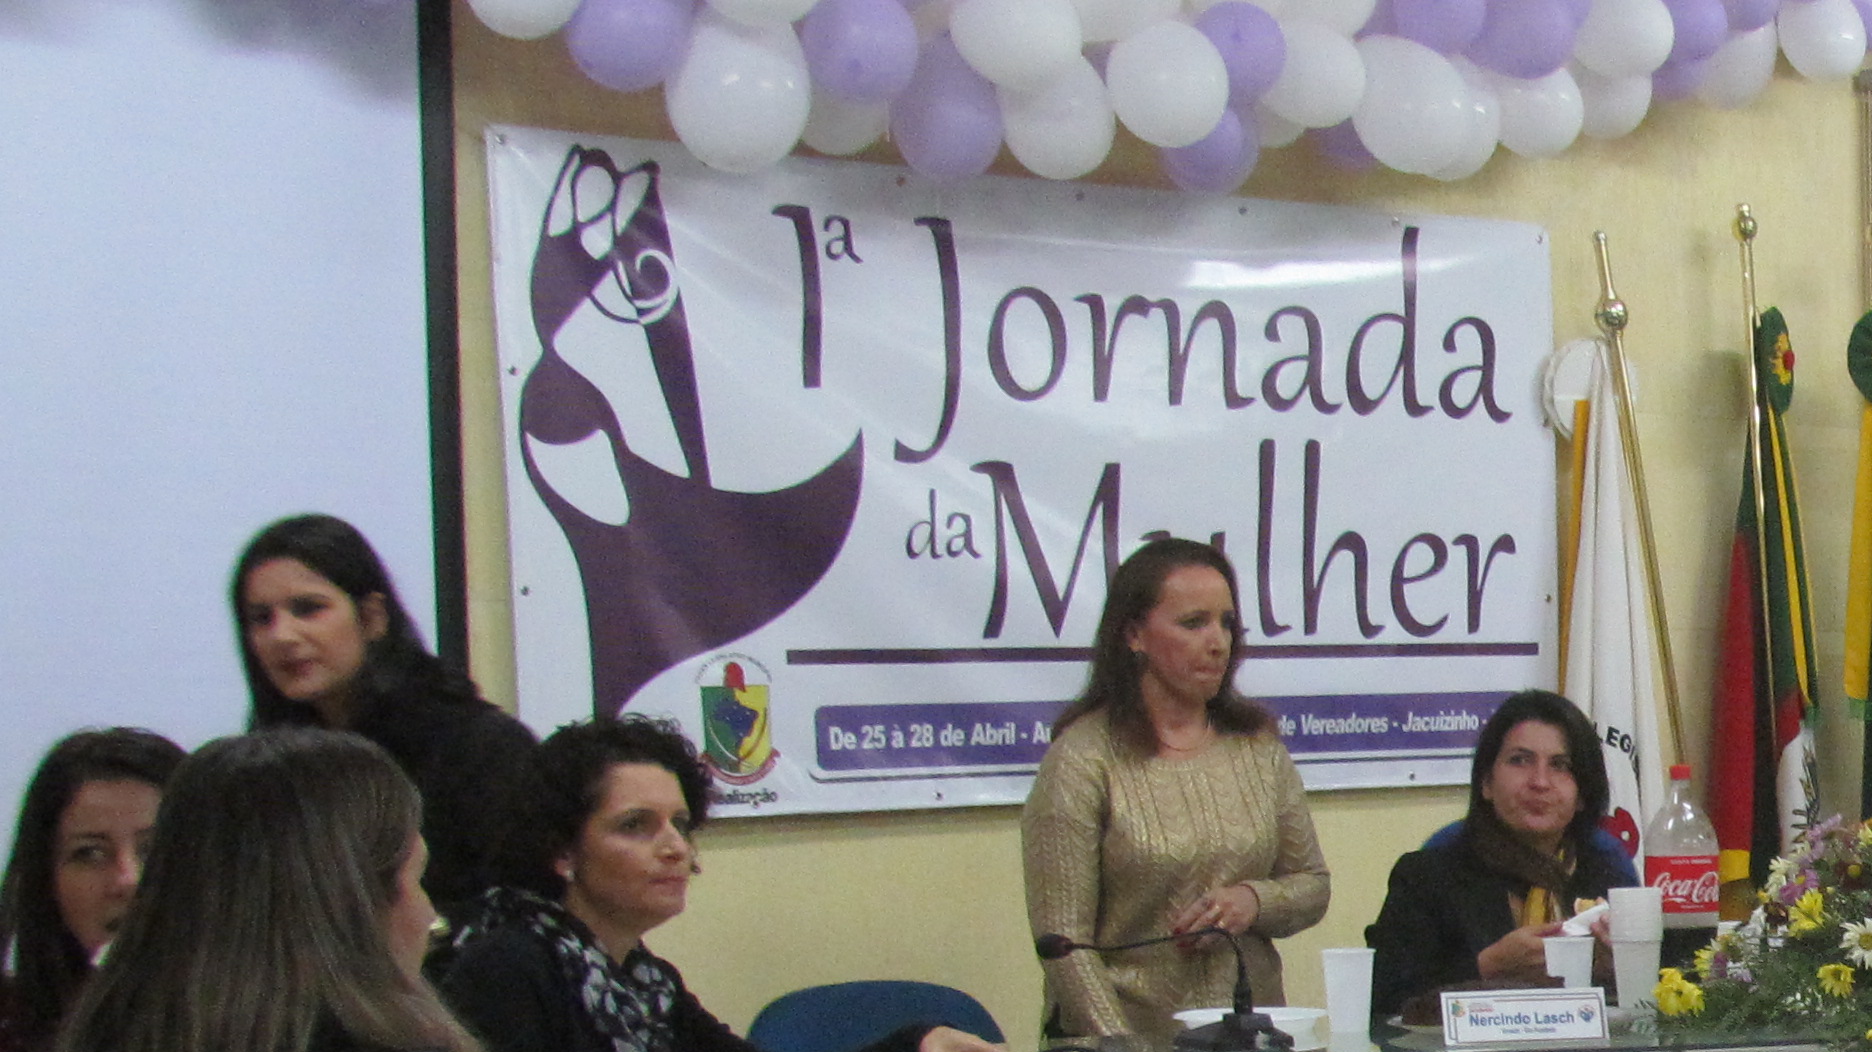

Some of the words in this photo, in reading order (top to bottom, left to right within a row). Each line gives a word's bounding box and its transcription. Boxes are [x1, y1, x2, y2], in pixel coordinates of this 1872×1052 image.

[894, 215, 1513, 464] Jornada
[905, 489, 982, 560] da
[970, 438, 1517, 640] Mlher
[829, 726, 857, 750] De
[861, 725, 886, 749] 25
[910, 723, 934, 747] 28
[940, 724, 965, 747] de
[970, 721, 1017, 746] Abril
[1301, 712, 1388, 736] Vereadores
[1403, 710, 1480, 733] Jacuizinho
[1469, 1011, 1531, 1027] Nercindo
[1534, 1011, 1574, 1024] Lasch
